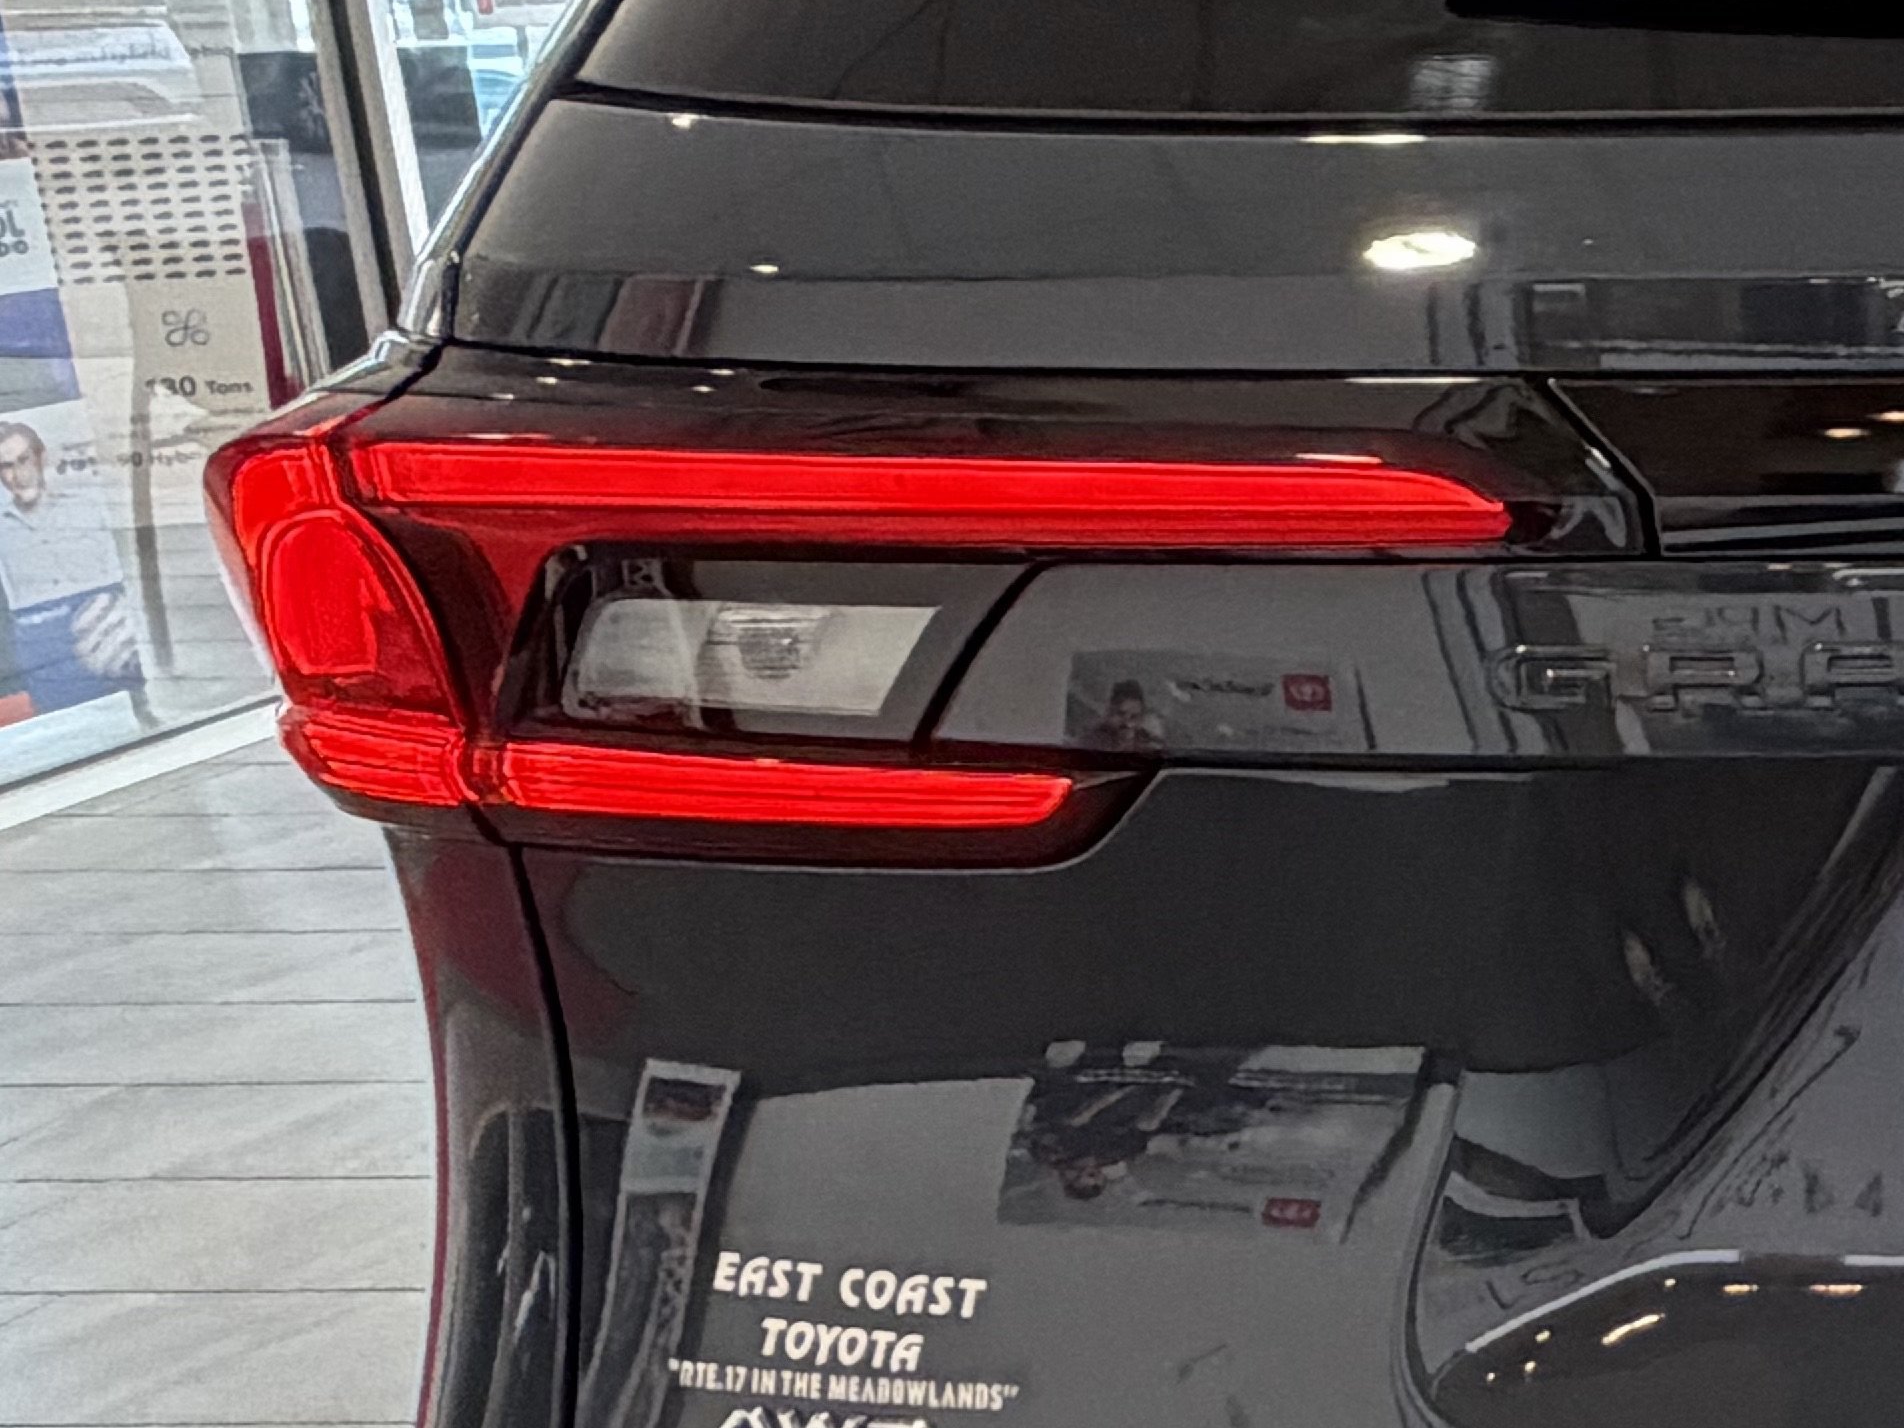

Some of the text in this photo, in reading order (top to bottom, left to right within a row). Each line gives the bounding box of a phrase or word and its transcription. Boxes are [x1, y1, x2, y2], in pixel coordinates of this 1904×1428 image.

[711, 1250, 988, 1319] EAST COAST
[760, 1317, 925, 1373] TOYOTA
[750, 1367, 777, 1397] IN
[780, 1369, 823, 1401] THE
